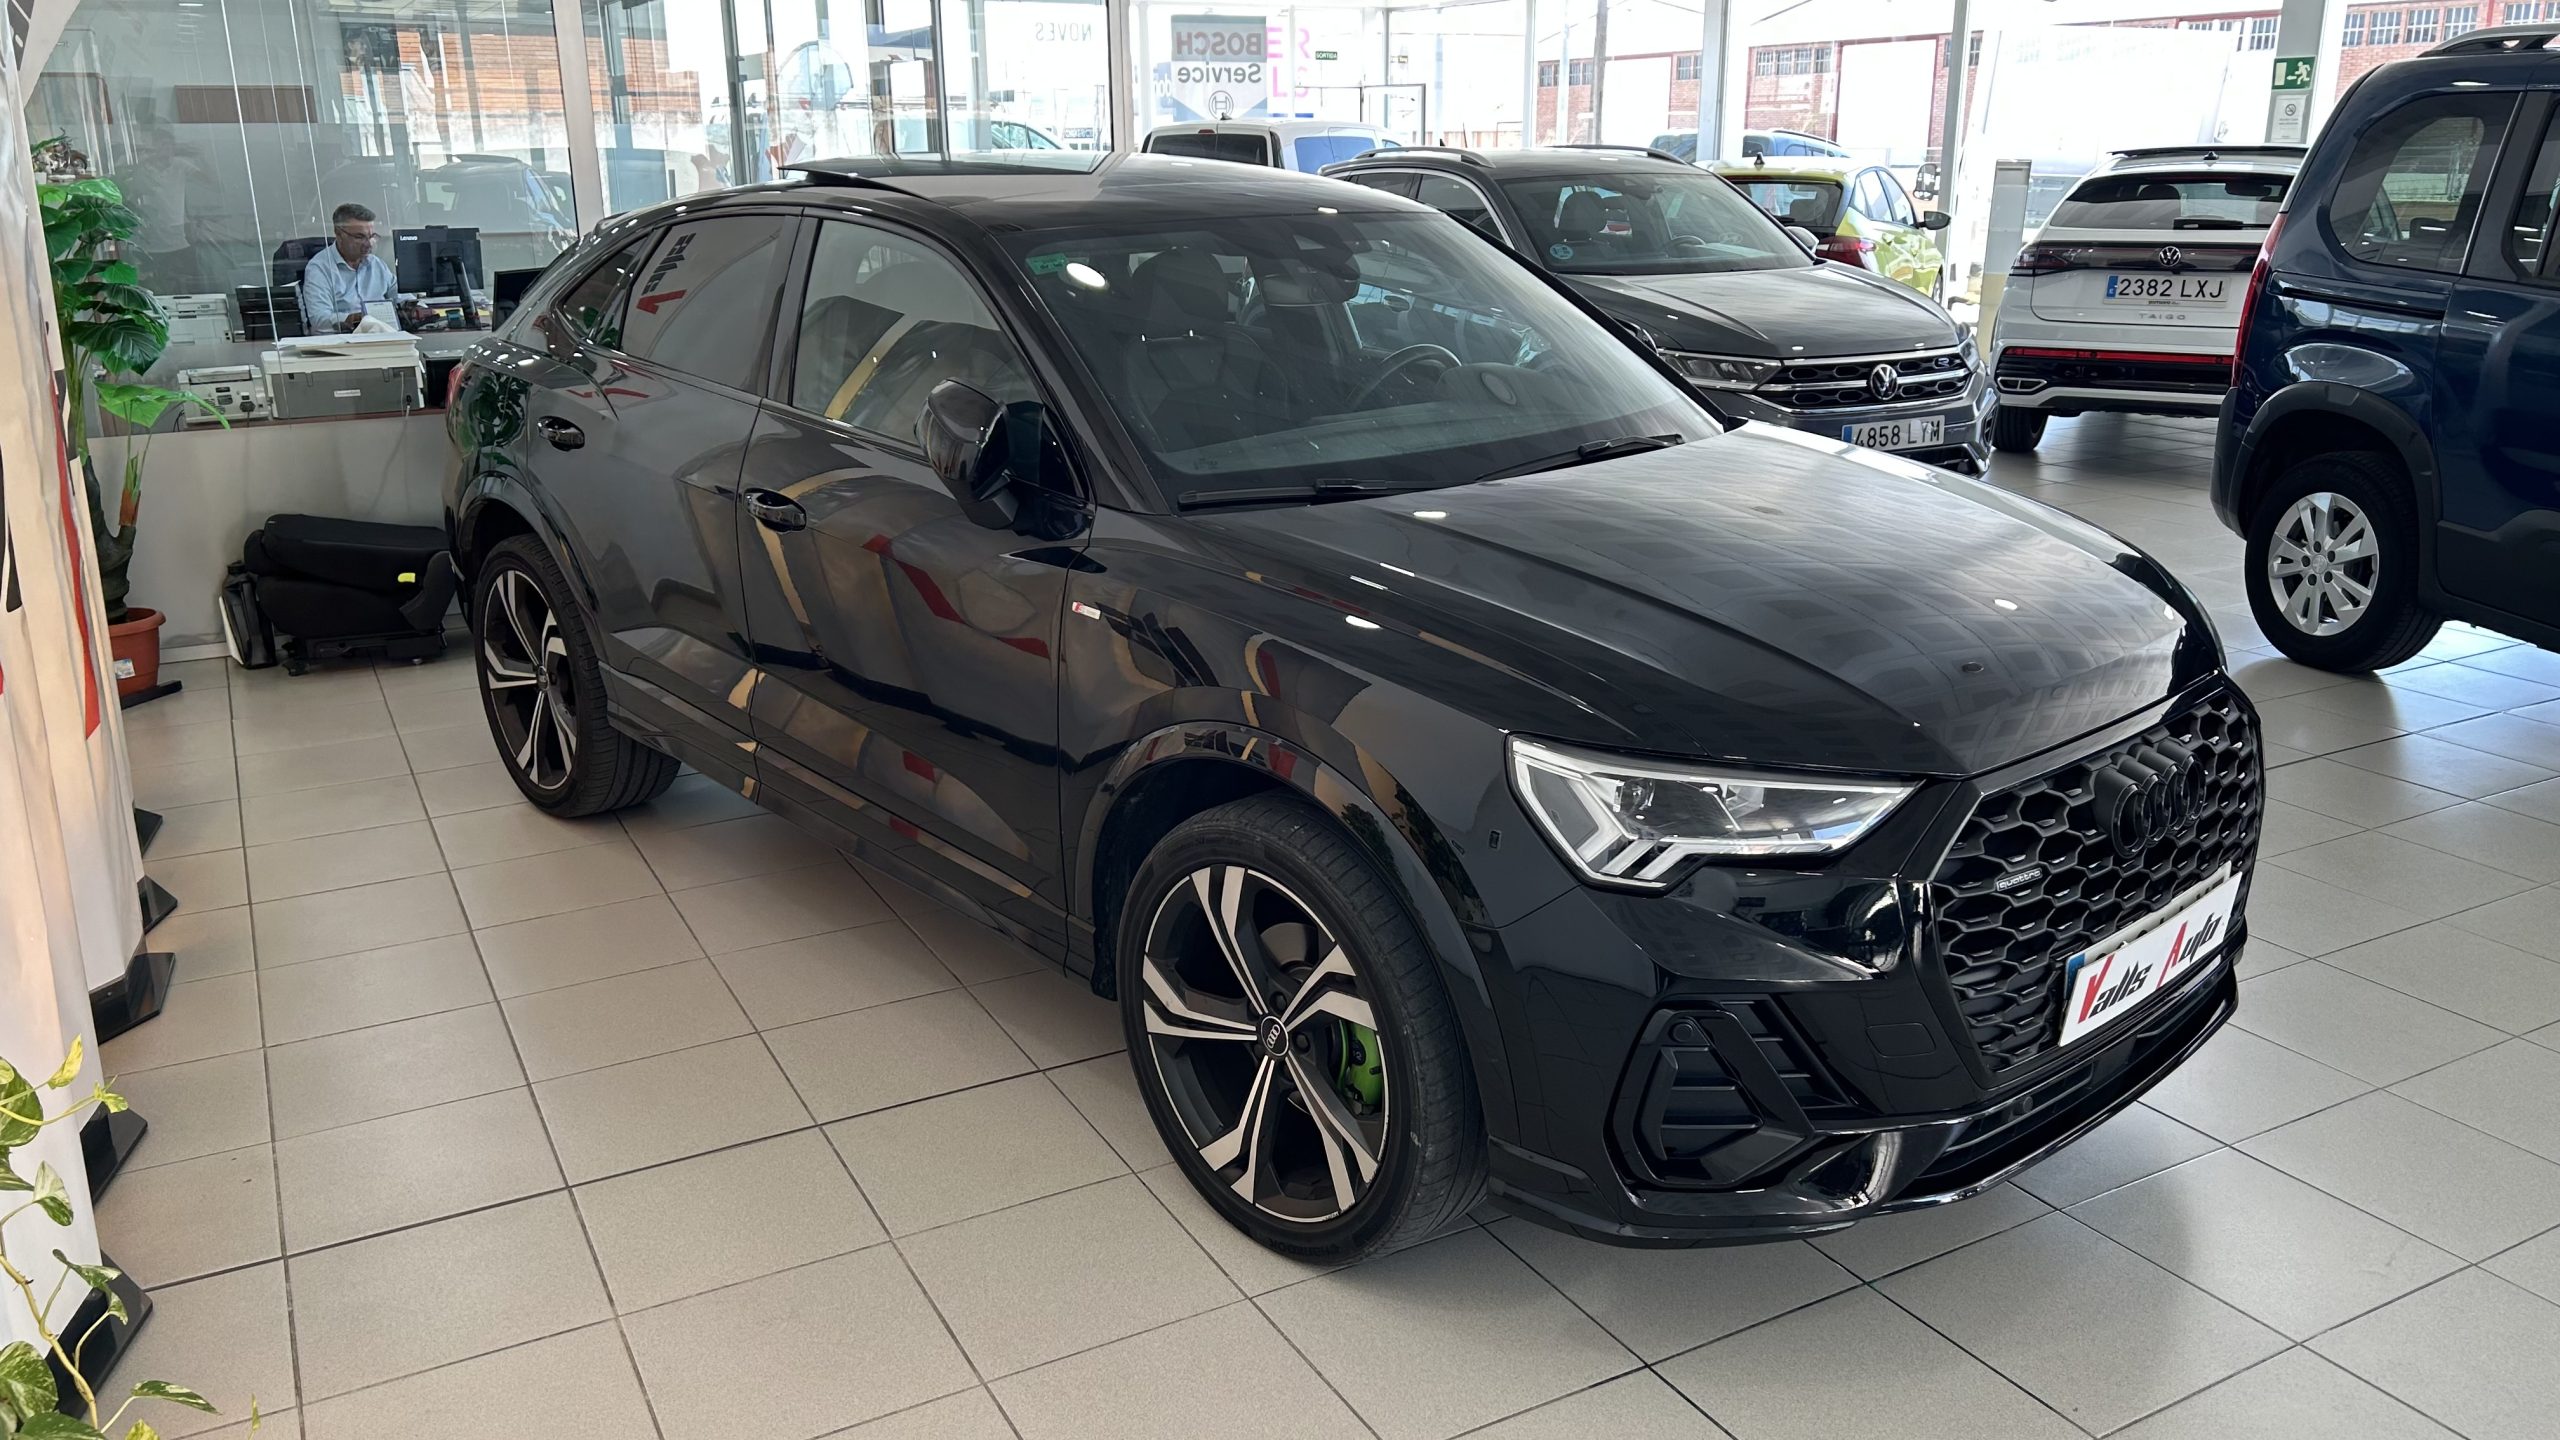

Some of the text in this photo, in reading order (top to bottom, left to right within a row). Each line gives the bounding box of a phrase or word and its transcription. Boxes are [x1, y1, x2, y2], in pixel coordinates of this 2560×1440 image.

[2118, 278, 2173, 297] 2382
[2180, 279, 2224, 299] LXJ
[2138, 312, 2186, 320] TAIGO
[1855, 420, 1941, 448] 4858 LYM
[1998, 869, 2041, 890] quattro
[2077, 953, 2154, 1024] Valls
[2156, 912, 2223, 990] Auto
